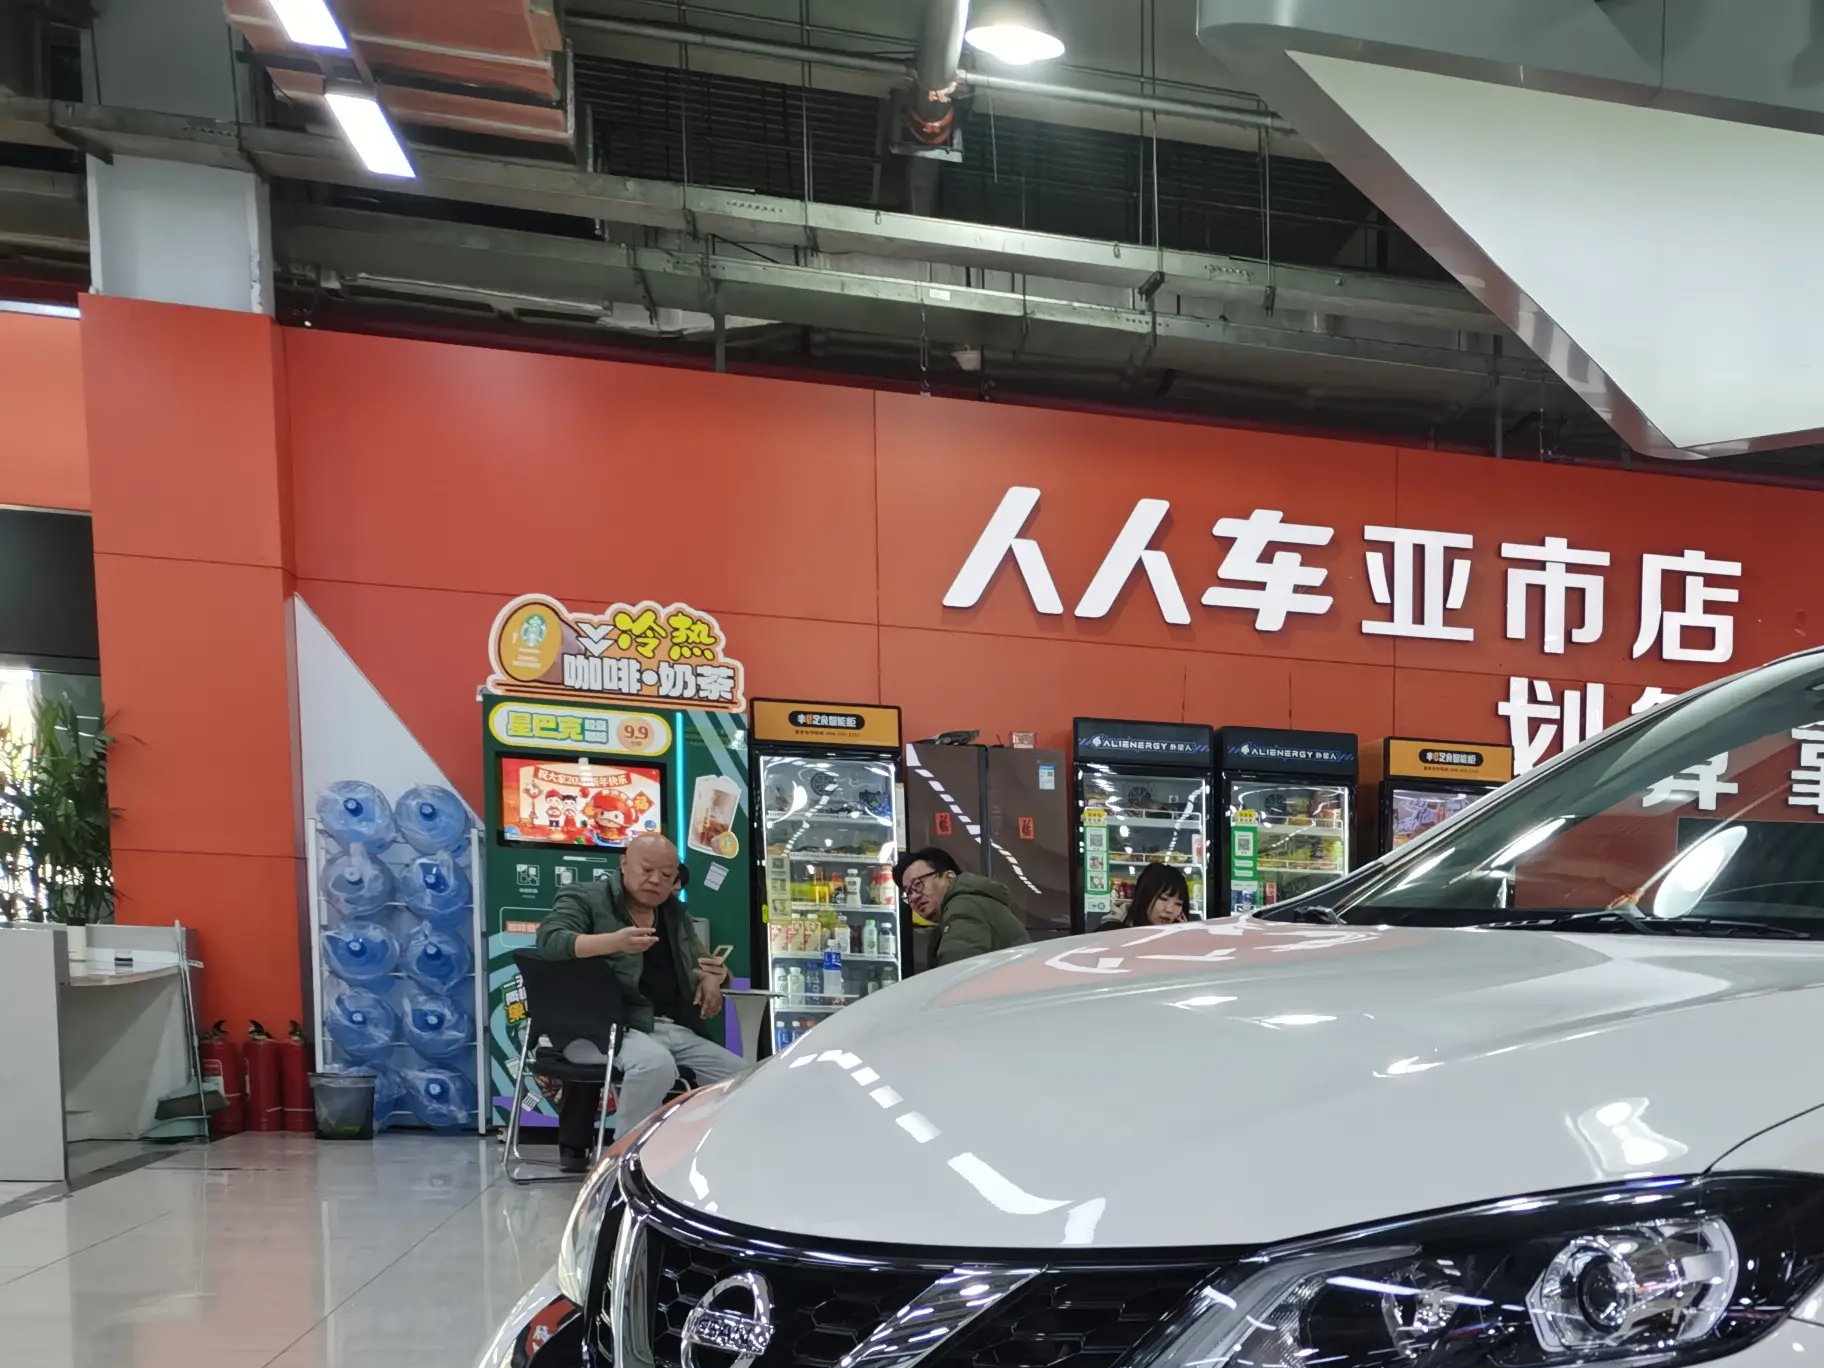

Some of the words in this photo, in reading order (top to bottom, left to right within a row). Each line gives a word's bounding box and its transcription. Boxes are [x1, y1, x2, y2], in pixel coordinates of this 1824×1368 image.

[613, 609, 717, 661] 冷热
[507, 711, 584, 742] 星巴克
[624, 725, 649, 740] 9.9
[1102, 739, 1168, 751] ALIENERGY
[1251, 748, 1313, 759] ALIENERGY
